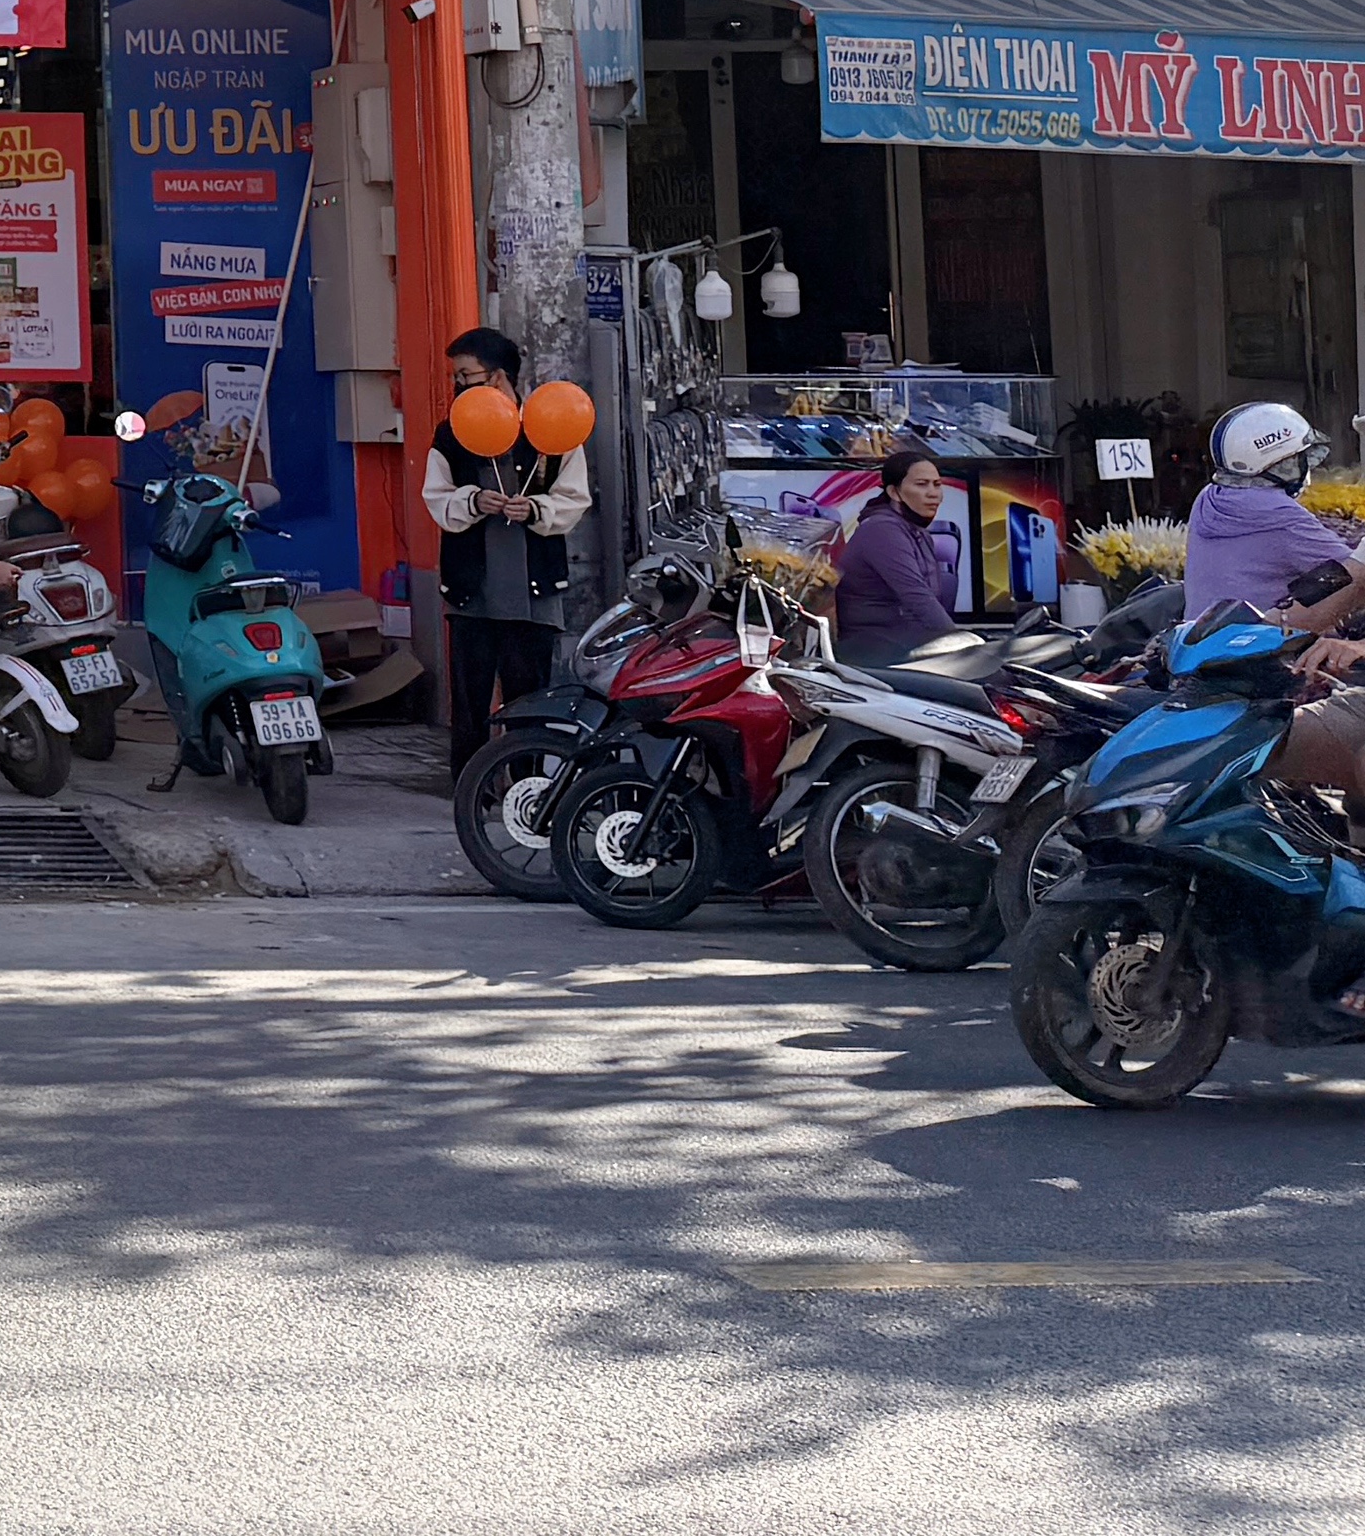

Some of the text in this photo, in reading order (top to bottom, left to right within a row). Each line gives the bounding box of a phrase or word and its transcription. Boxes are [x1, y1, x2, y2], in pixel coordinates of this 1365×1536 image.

[126, 29, 289, 54] MUA ONLINE
[924, 24, 1076, 103] ĐIỆN THOẠI
[154, 66, 264, 91] NGẬP TRÀN
[1088, 29, 1365, 146] MỸ LINH
[129, 99, 293, 154] ƯU ĐÃI
[165, 180, 243, 192] MUA NGAY
[49, 204, 58, 217] 1
[171, 247, 257, 274] NẮNG MƯA
[155, 291, 186, 309] VIỆC
[223, 287, 252, 303] CON
[172, 321, 201, 338] LƯỜI
[206, 326, 224, 339] RA
[215, 389, 259, 401] OneLife
[1253, 430, 1282, 450] BIDV
[1108, 440, 1146, 472] 15K
[70, 654, 109, 675] 59-F1
[261, 700, 308, 722] 59-TA
